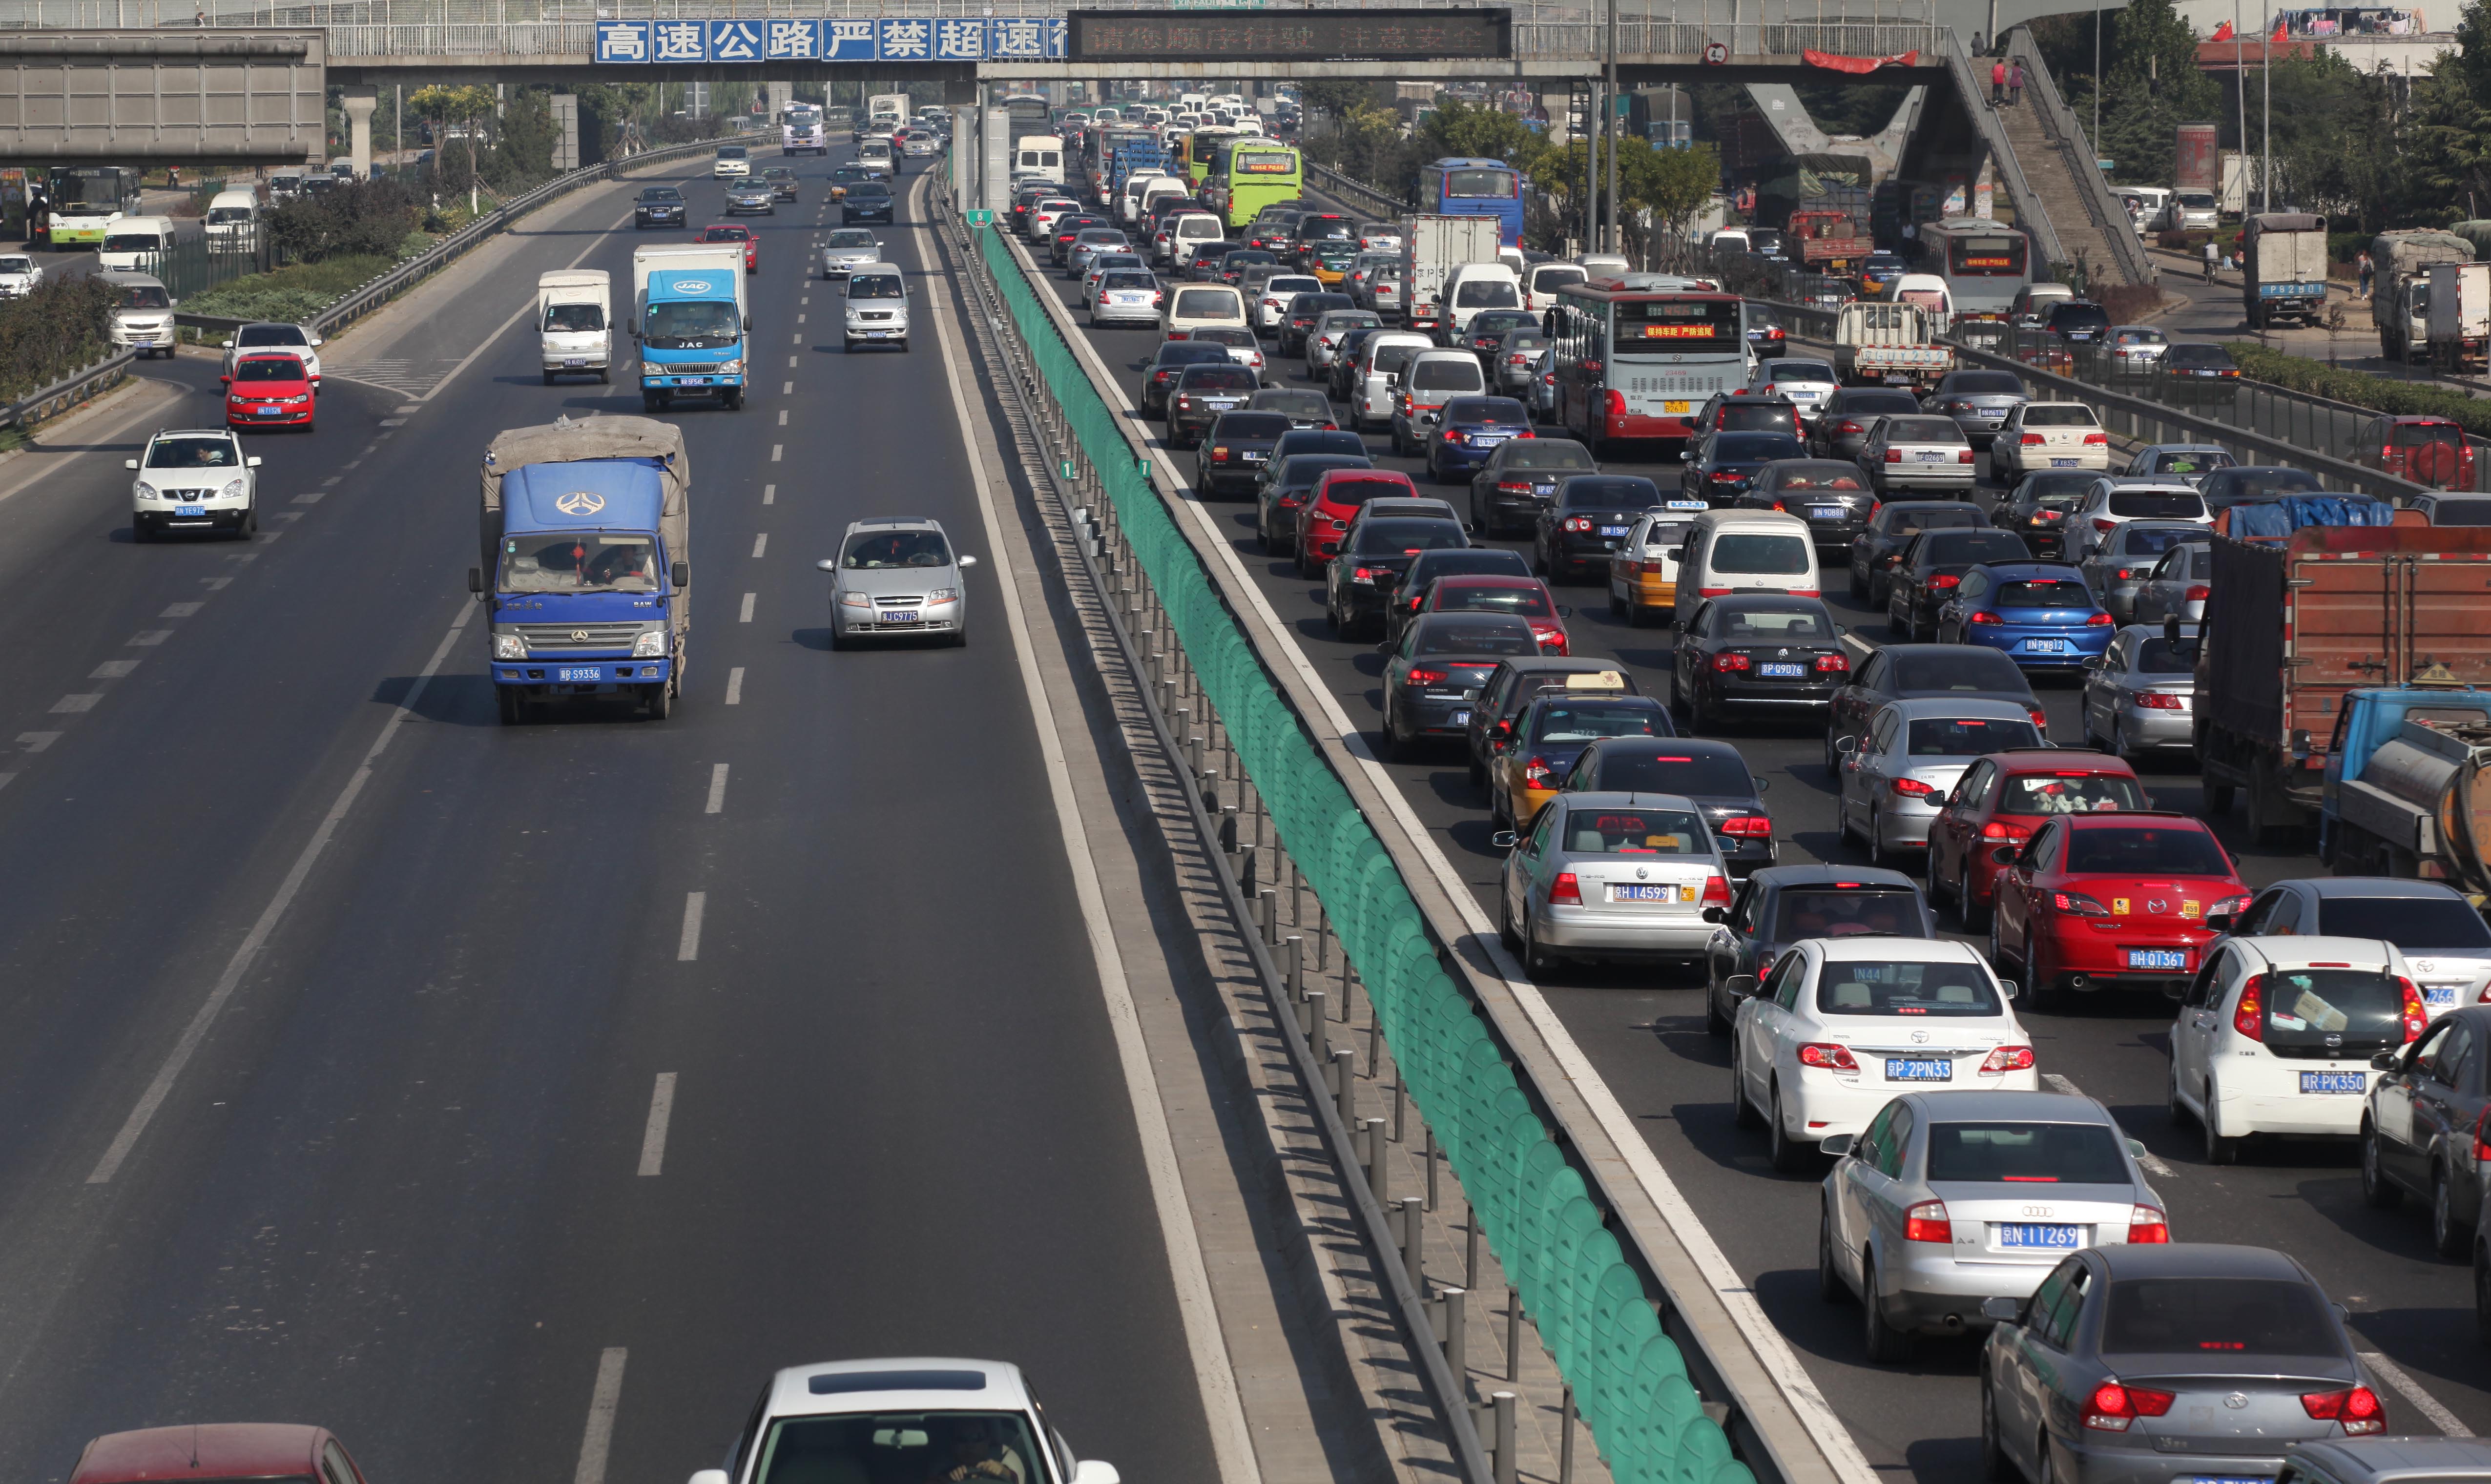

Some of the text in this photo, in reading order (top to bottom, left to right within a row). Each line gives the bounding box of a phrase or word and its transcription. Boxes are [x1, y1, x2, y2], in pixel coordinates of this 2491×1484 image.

[977, 212, 982, 220] 8
[1648, 328, 1714, 336] 保持车距 严防追尾
[1142, 462, 1147, 475] 1
